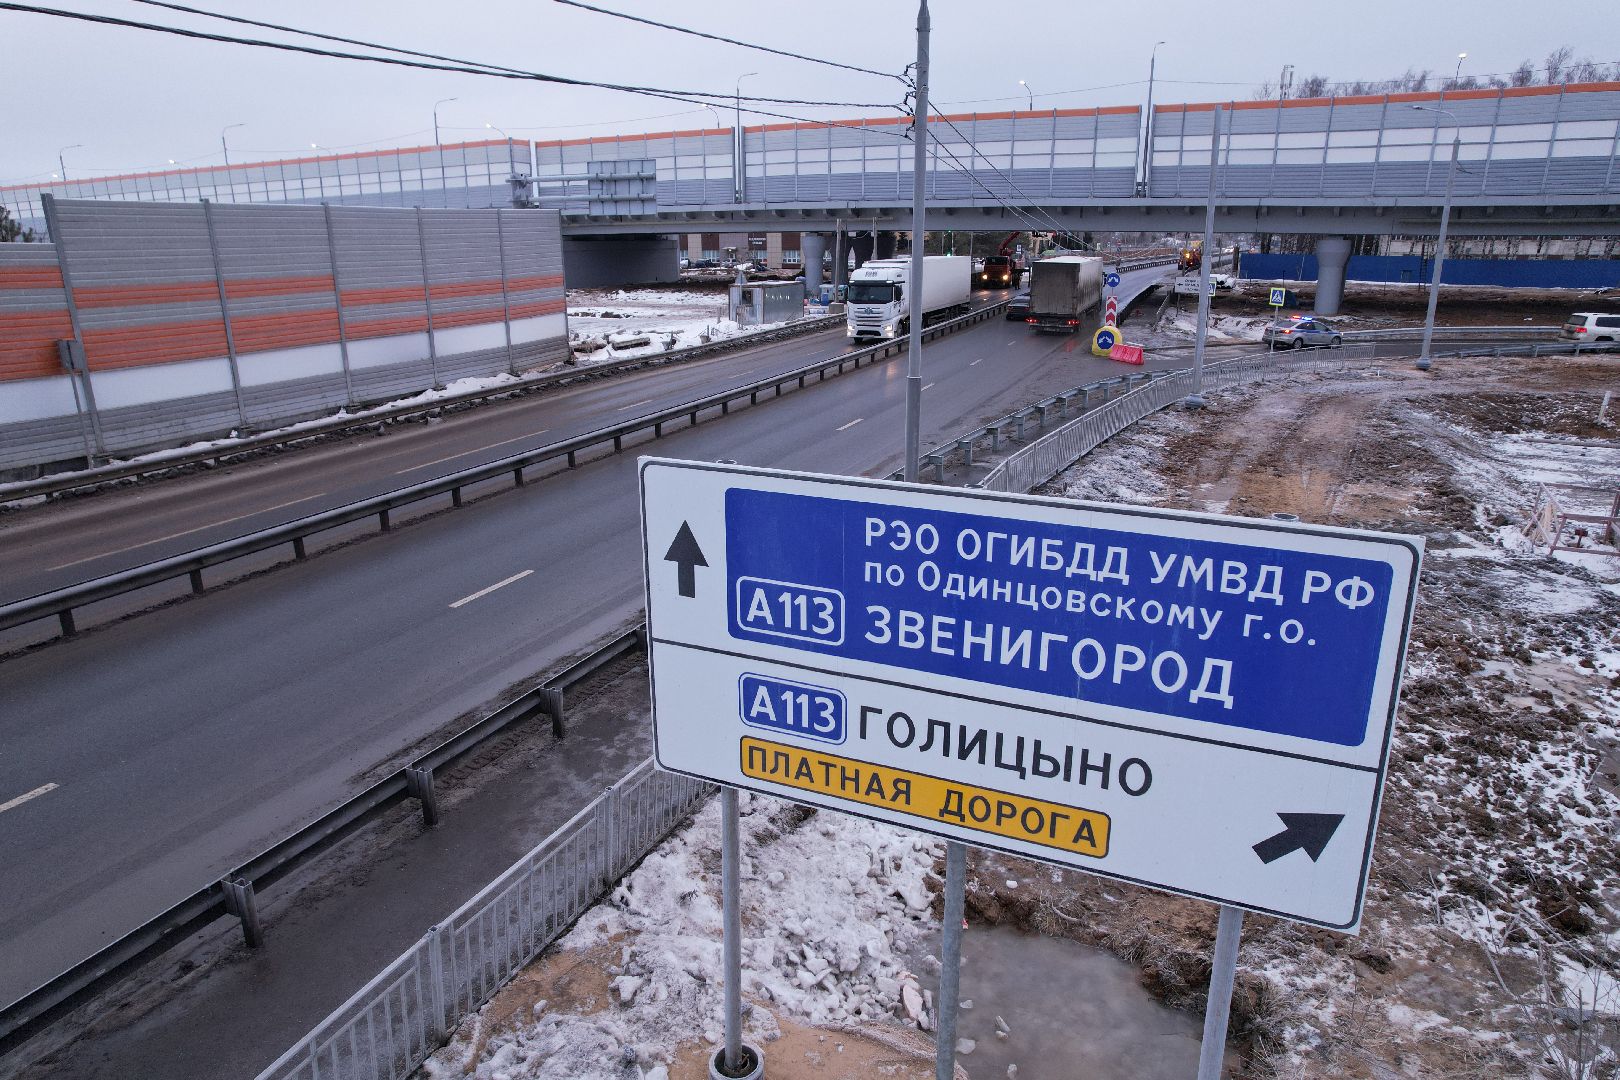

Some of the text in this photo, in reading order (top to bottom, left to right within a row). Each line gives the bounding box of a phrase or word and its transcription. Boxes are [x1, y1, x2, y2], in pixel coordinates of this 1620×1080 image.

[864, 560, 1316, 646] по Одинцовскому г.о.
[865, 517, 1375, 610] РЭО ОГИБДД УМВД РФ
[864, 604, 1235, 710] ЗВЕНИГОРОД
[748, 745, 1098, 849] ПЛАТНАЯ ДОРОГА
[859, 704, 1152, 797] ГОЛИЦЫНО
